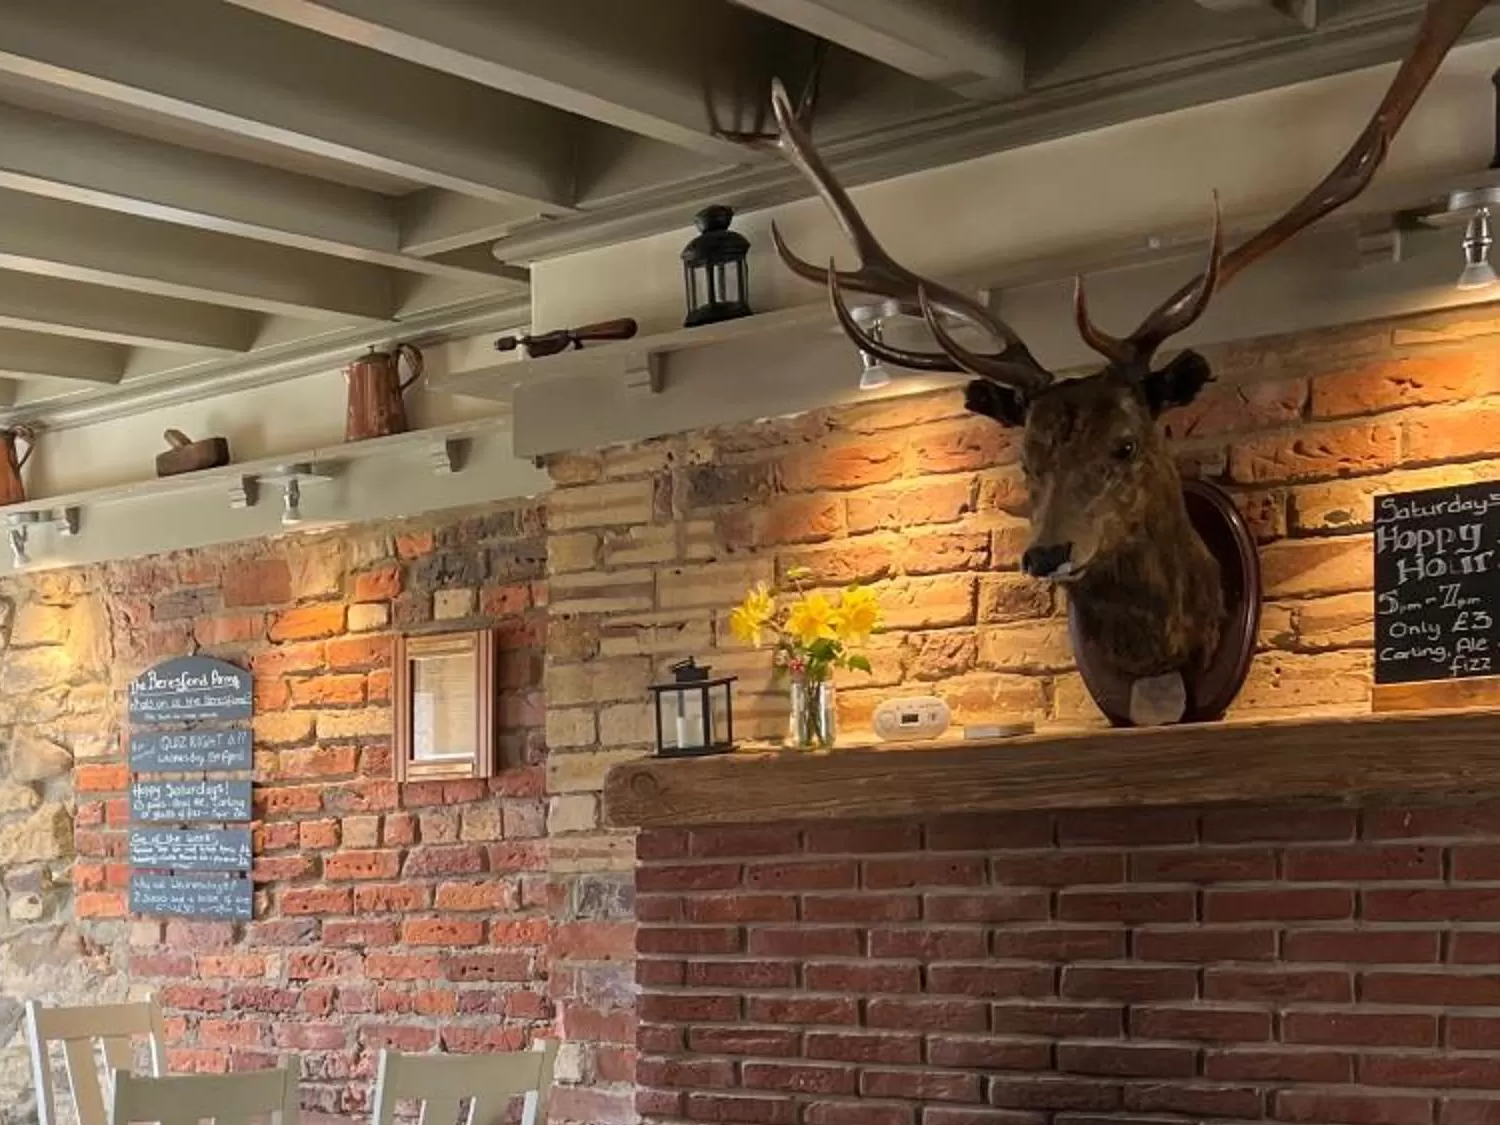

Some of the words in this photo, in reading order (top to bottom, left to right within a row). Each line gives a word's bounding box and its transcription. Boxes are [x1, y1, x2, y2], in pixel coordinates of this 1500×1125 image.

[1377, 523, 1484, 555] Happy
[1396, 549, 1495, 585] Hour
[1389, 620, 1441, 641] Only
[1451, 611, 1493, 633] £3
[1456, 637, 1488, 653] Ale
[1448, 655, 1492, 677] fizz
